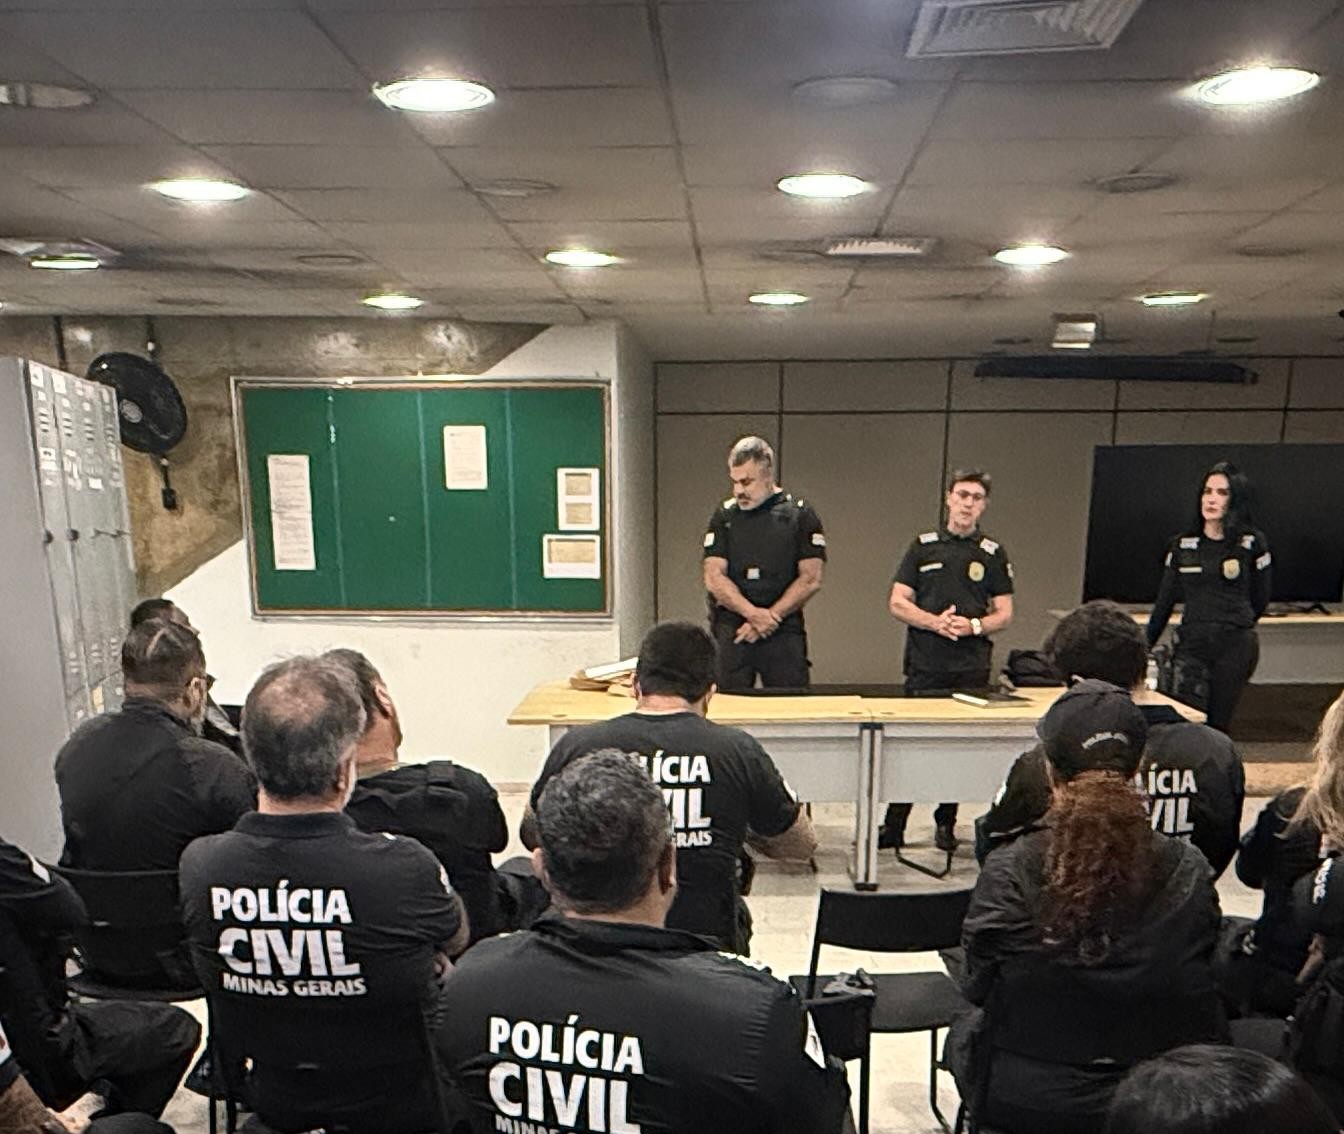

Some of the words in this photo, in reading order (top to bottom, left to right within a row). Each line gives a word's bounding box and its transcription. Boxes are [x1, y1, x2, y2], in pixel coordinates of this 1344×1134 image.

[211, 880, 353, 924] POLÍCIA
[217, 927, 361, 976] CIVIL
[222, 973, 289, 996] MINAS
[293, 977, 367, 997] GERAIS
[489, 1014, 644, 1075] POLÍCIA
